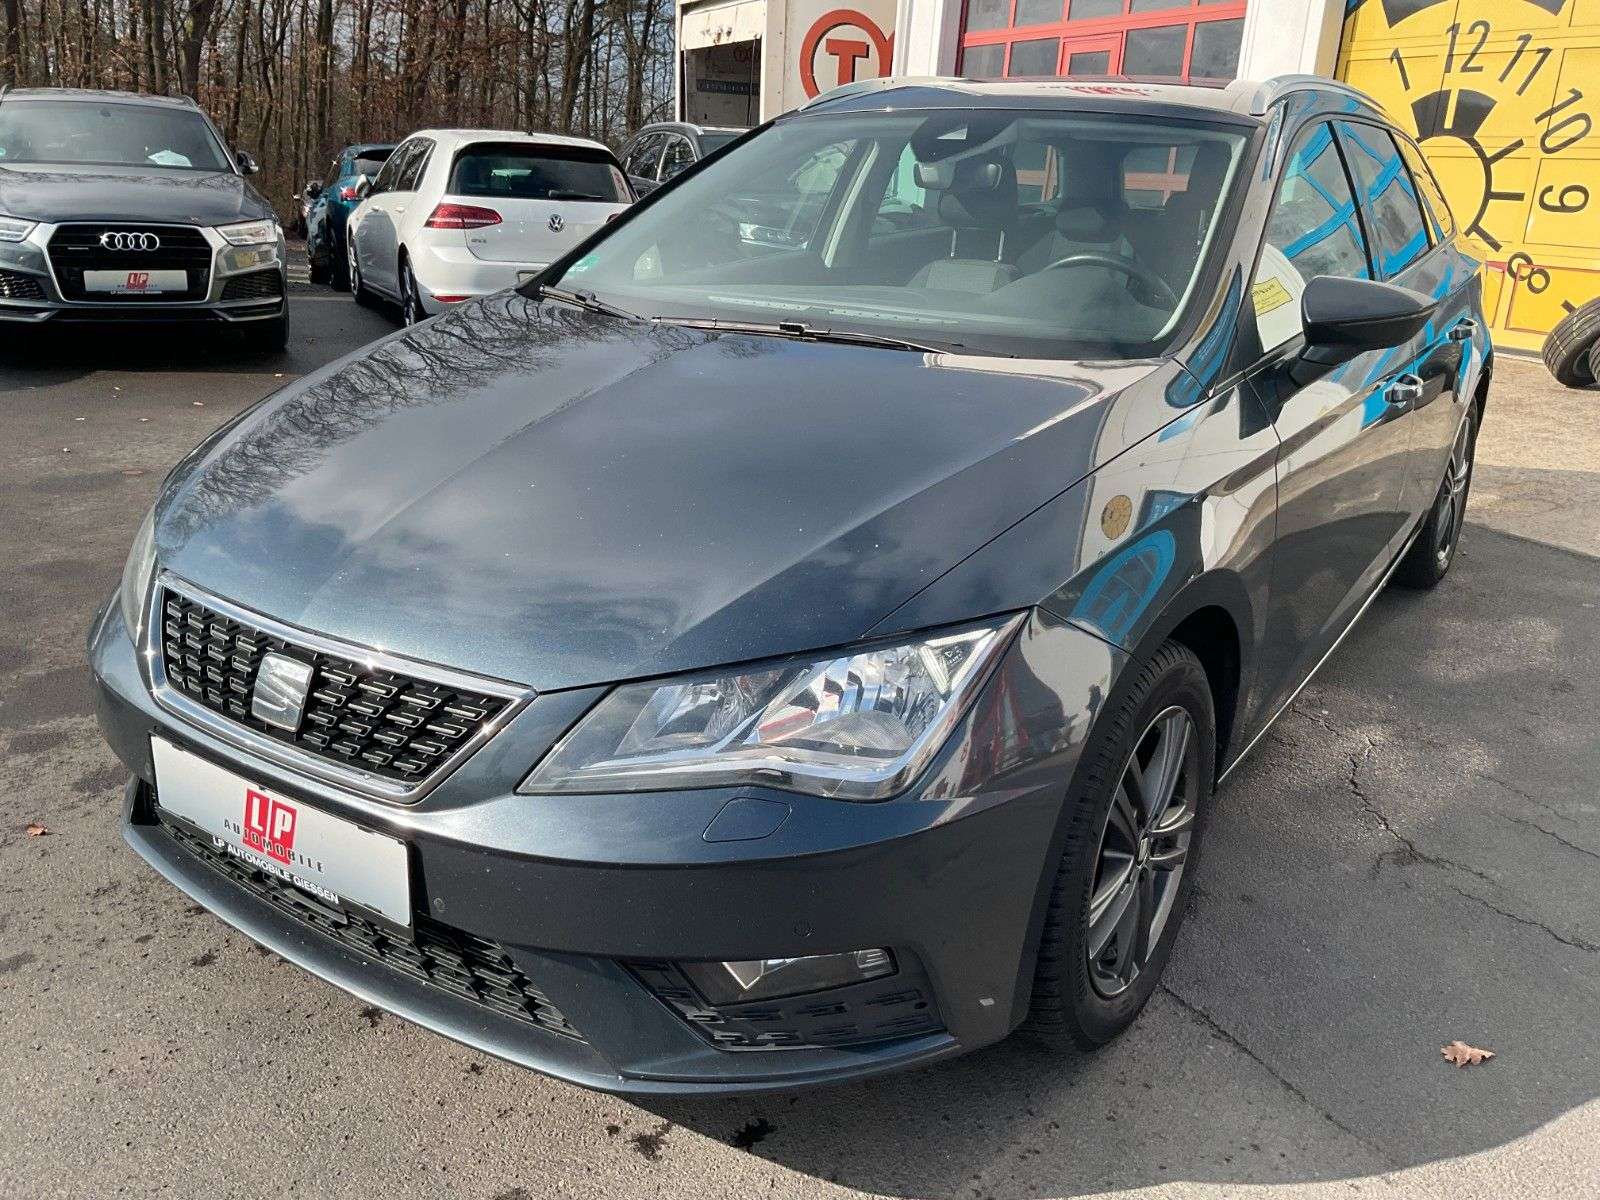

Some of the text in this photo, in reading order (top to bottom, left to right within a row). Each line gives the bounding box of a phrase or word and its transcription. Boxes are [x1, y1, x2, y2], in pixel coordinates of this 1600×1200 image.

[1389, 47, 1411, 91] 1
[1445, 20, 1490, 74] 12
[1498, 33, 1553, 96] 11
[1534, 87, 1592, 154] 10
[1507, 251, 1550, 294] 8
[251, 796, 293, 840] LP
[224, 818, 325, 873] AUTOMOBILE
[228, 844, 292, 882] AUTOMOBILE
[293, 874, 340, 905] GIESSEN
